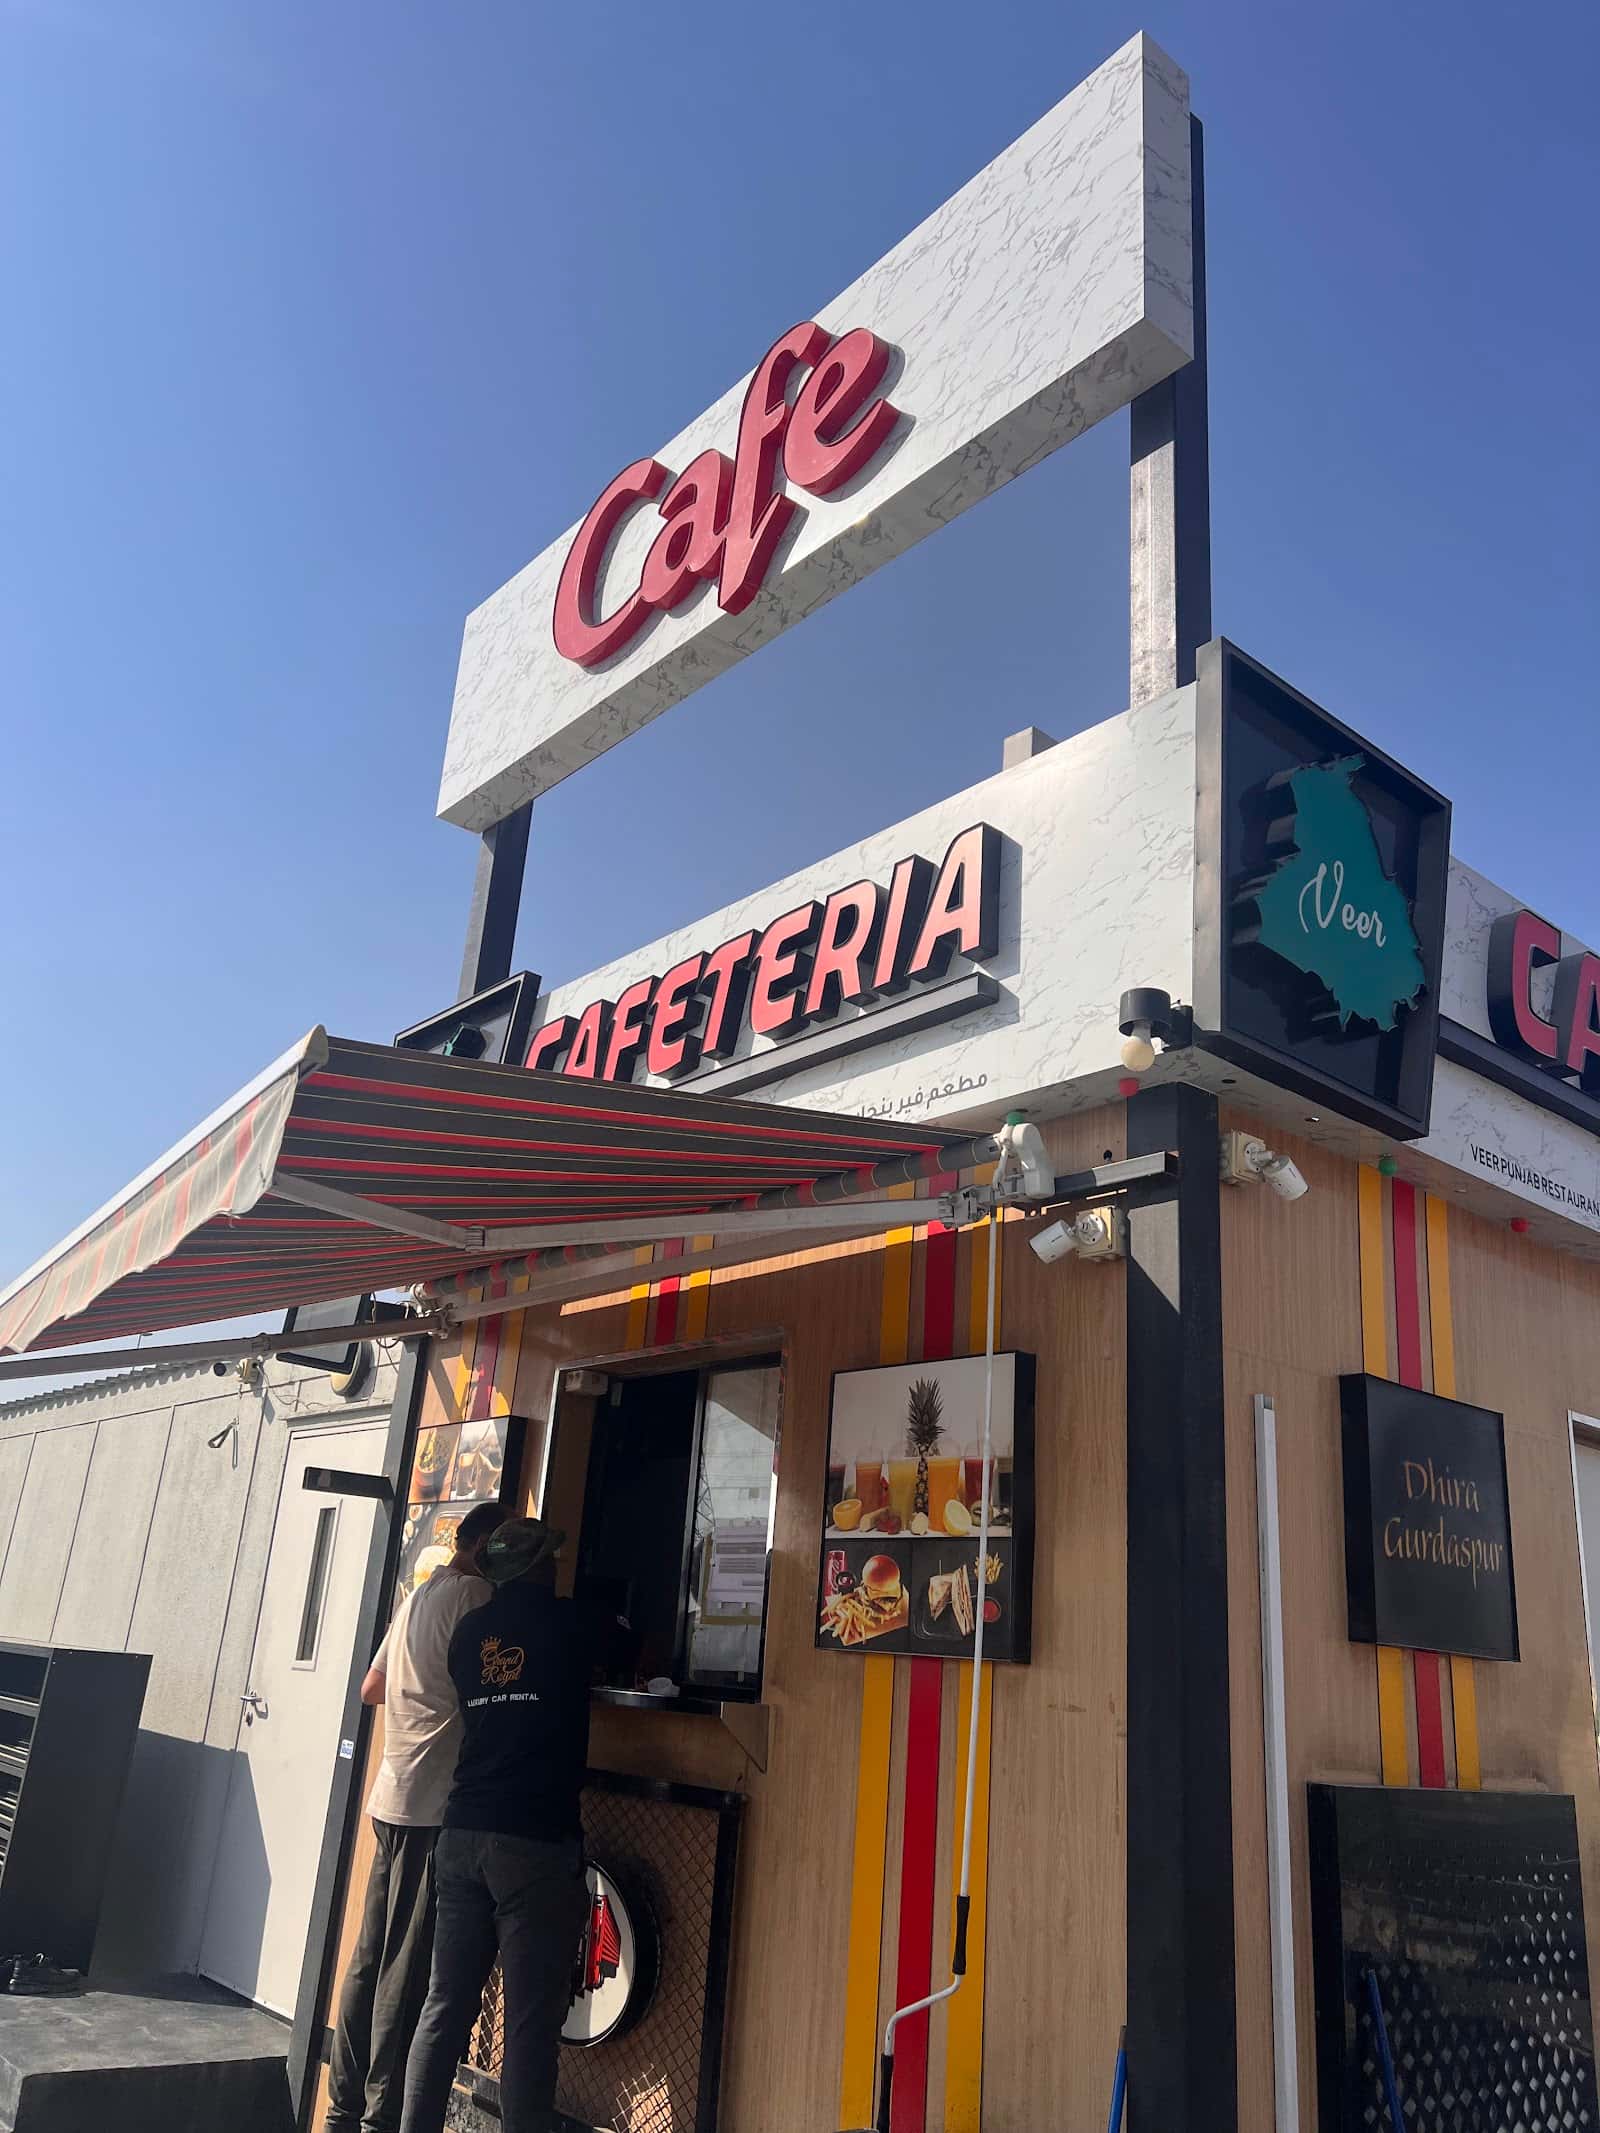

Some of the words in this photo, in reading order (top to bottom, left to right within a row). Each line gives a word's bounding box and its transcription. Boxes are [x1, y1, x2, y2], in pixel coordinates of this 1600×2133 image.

[552, 320, 900, 668] Cafe
[1298, 860, 1387, 948] Veer
[896, 1086, 924, 1114] فير
[926, 1073, 988, 1109] مطعم
[1470, 1143, 1500, 1172] VEER
[1500, 1158, 1541, 1190] PUNJAB
[1403, 1457, 1480, 1513] Dhira
[1383, 1516, 1503, 1590] Gurdaspur
[491, 1694, 507, 1703] CAR
[509, 1693, 540, 1701] RENTAL
